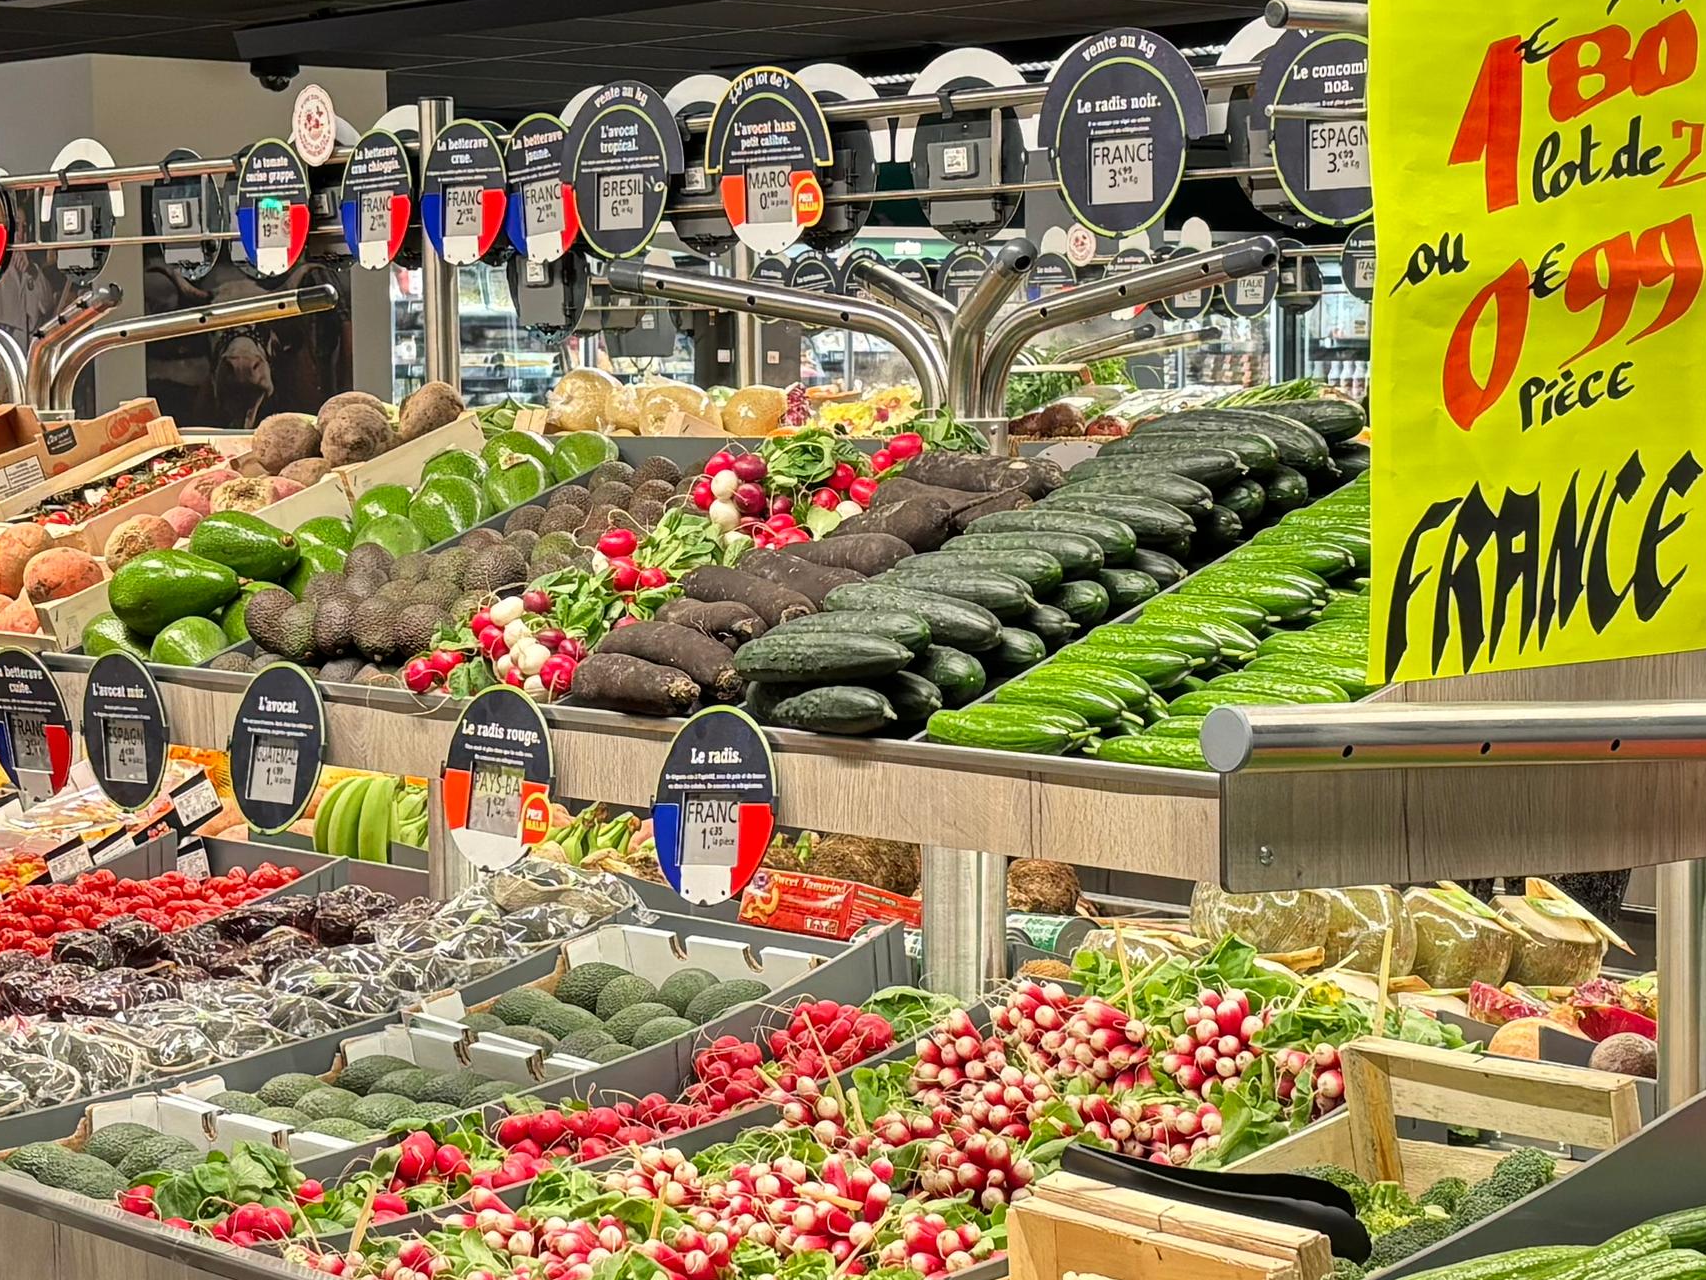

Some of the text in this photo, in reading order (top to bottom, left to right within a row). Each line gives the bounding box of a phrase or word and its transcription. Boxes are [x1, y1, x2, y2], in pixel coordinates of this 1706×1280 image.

[1082, 33, 1157, 62] vente au kg
[755, 72, 769, 86] lot
[1293, 65, 1309, 80] Le
[594, 86, 649, 108] vente au kg
[1324, 81, 1354, 94] noa.
[1076, 92, 1162, 115] Le radis noir.
[600, 123, 639, 139] L'avocat
[734, 122, 772, 137] L'avocat
[1311, 125, 1368, 149] ESPAGN
[436, 136, 488, 151] La betterave
[512, 130, 564, 150] La betterave
[600, 138, 639, 156] tropical.
[741, 134, 791, 151] petit calibre.
[253, 156, 289, 169] La tomate
[354, 145, 398, 161] La betterave
[1093, 142, 1153, 167] FRANCE
[1532, 124, 1602, 204] lot
[1601, 115, 1666, 182] de
[447, 188, 483, 208] FRANC
[524, 183, 561, 207] FRANC
[602, 179, 644, 198] BRESIL
[362, 195, 392, 213] FRANC
[1389, 231, 1469, 296] ou
[1384, 449, 1703, 684] FRANCE
[4, 664, 44, 680] betterave
[92, 682, 126, 698] L'avocat
[258, 696, 299, 714] L'avocat.
[11, 719, 45, 738] FRANC
[109, 726, 143, 747] ESPAGN
[462, 719, 541, 746] Le radis rouge.
[691, 746, 742, 764] Le radis.
[474, 772, 521, 796] PAYS-BA
[687, 801, 739, 823] FRANC
[772, 873, 848, 894] Sweet Tamarind
